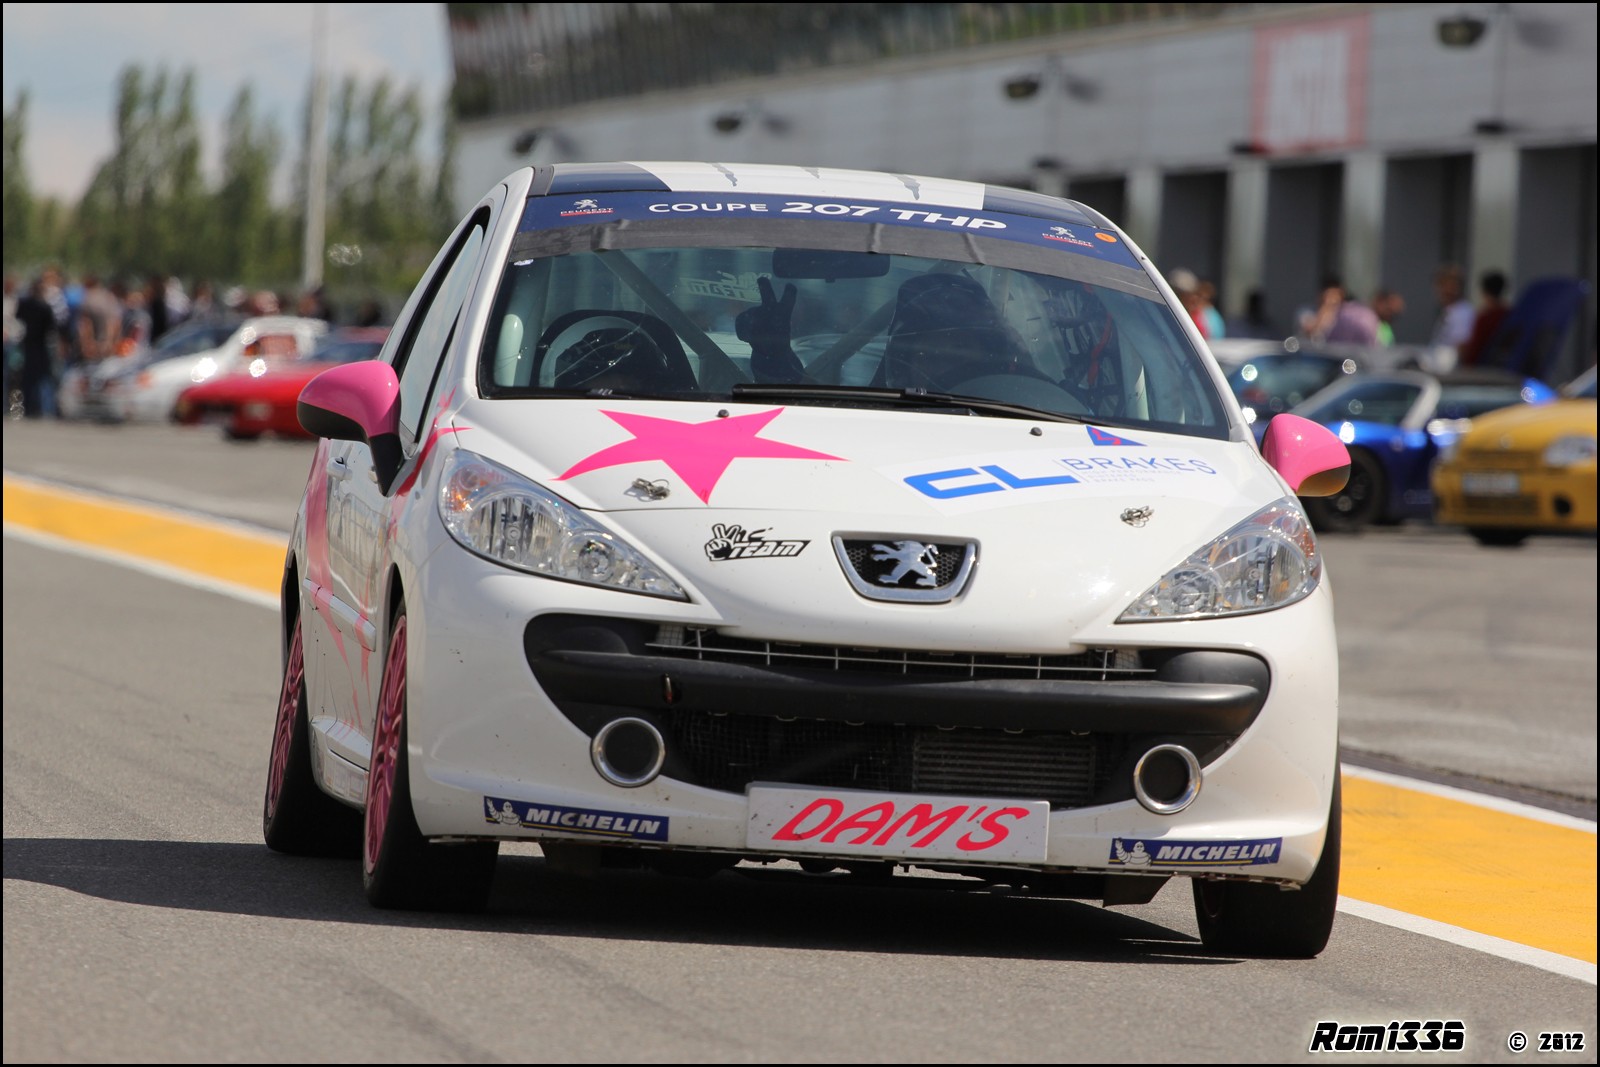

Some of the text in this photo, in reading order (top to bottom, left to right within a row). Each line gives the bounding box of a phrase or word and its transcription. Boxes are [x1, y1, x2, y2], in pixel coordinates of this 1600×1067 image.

[649, 202, 1008, 229] COUPE 207 THP
[903, 457, 1217, 500] CL BRAKES
[526, 808, 660, 834] MICHELIN
[771, 798, 1030, 851] DAM'S
[1155, 843, 1277, 860] MICHELIN
